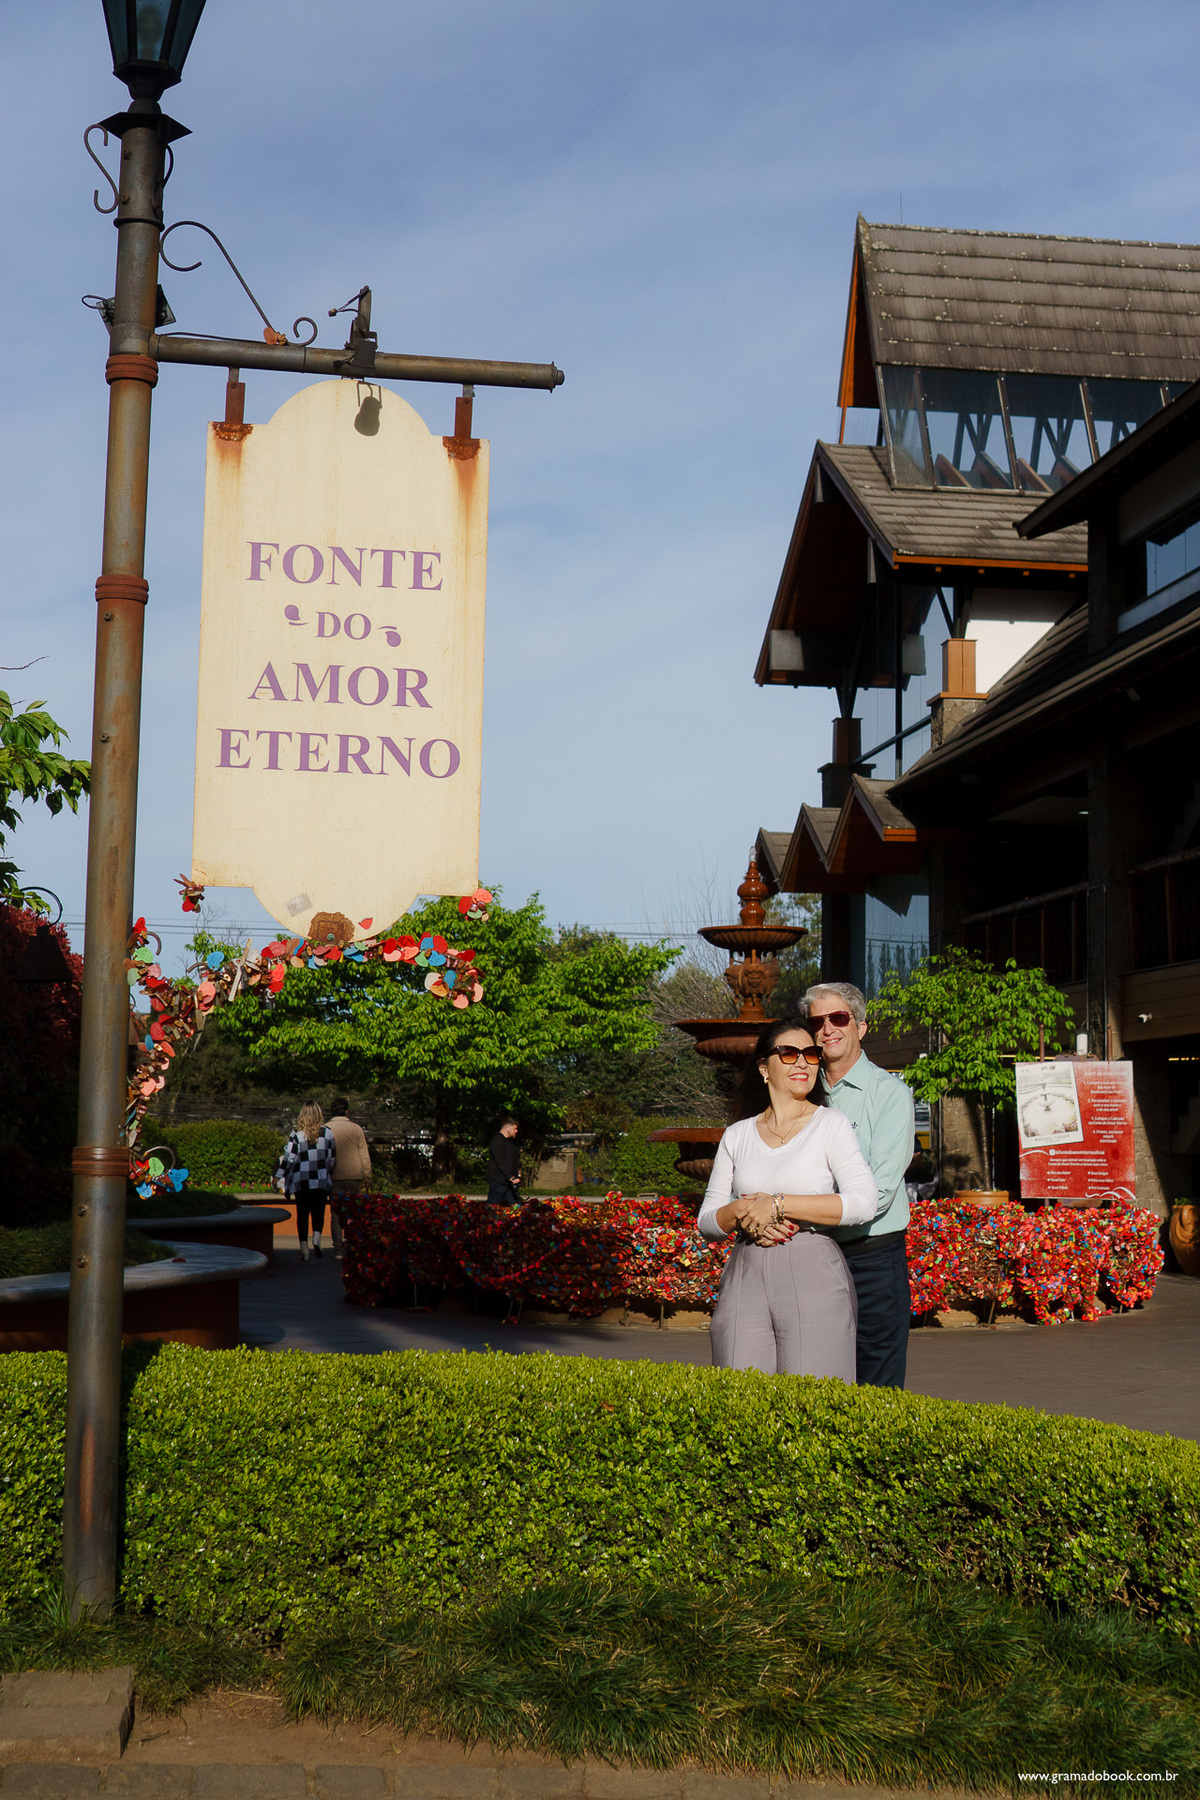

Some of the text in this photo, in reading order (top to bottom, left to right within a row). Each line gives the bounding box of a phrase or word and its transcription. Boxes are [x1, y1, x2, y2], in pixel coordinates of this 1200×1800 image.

[245, 541, 443, 591] FONTE
[315, 611, 372, 640] DO
[247, 660, 433, 708] AMOR
[215, 727, 461, 779] ETERNO
